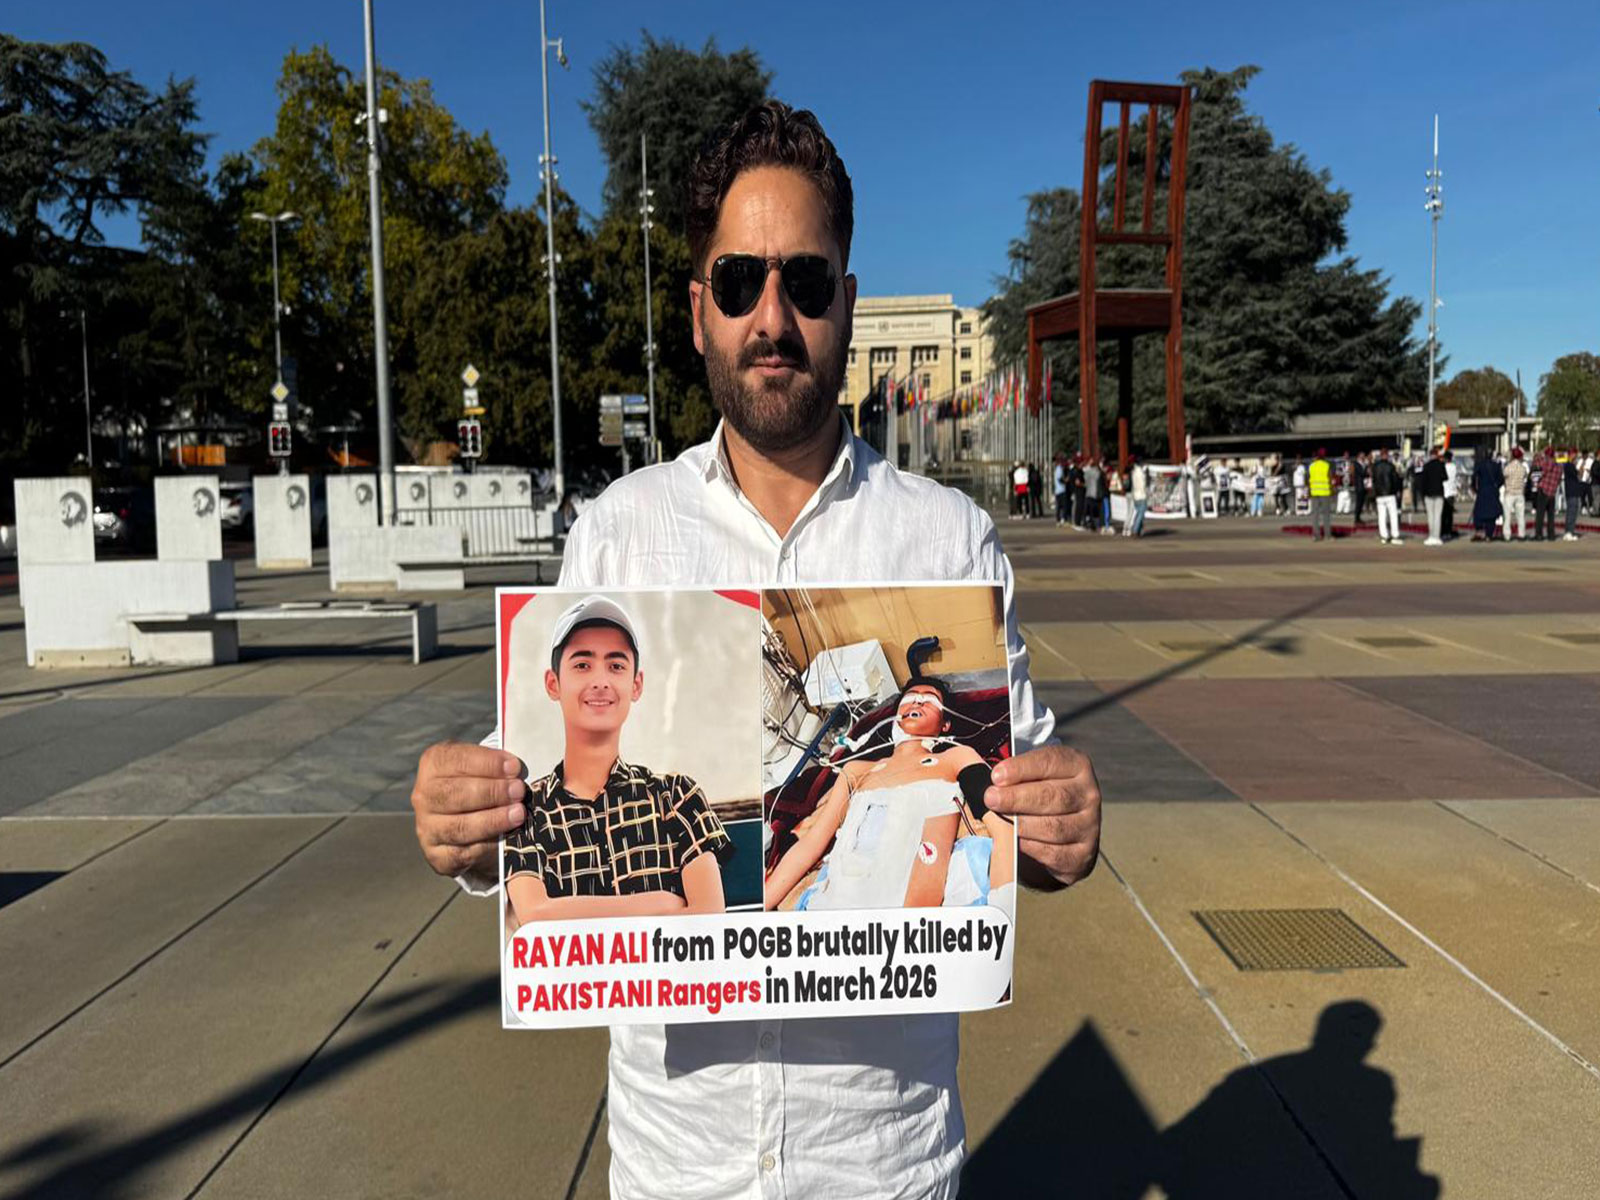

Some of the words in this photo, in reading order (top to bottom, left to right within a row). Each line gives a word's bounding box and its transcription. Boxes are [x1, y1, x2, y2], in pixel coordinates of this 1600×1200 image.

[513, 932, 604, 969] RAYAN
[609, 931, 648, 965] ALI
[652, 927, 715, 963] from
[723, 926, 792, 960] POGB
[797, 921, 900, 966] brutally
[904, 917, 973, 954] killed
[978, 919, 1008, 961] by
[517, 979, 653, 1012] PAKISTANI
[657, 979, 762, 1015] Rangers
[765, 965, 789, 1004] in
[794, 966, 875, 1003] March
[879, 963, 938, 999] 2026
